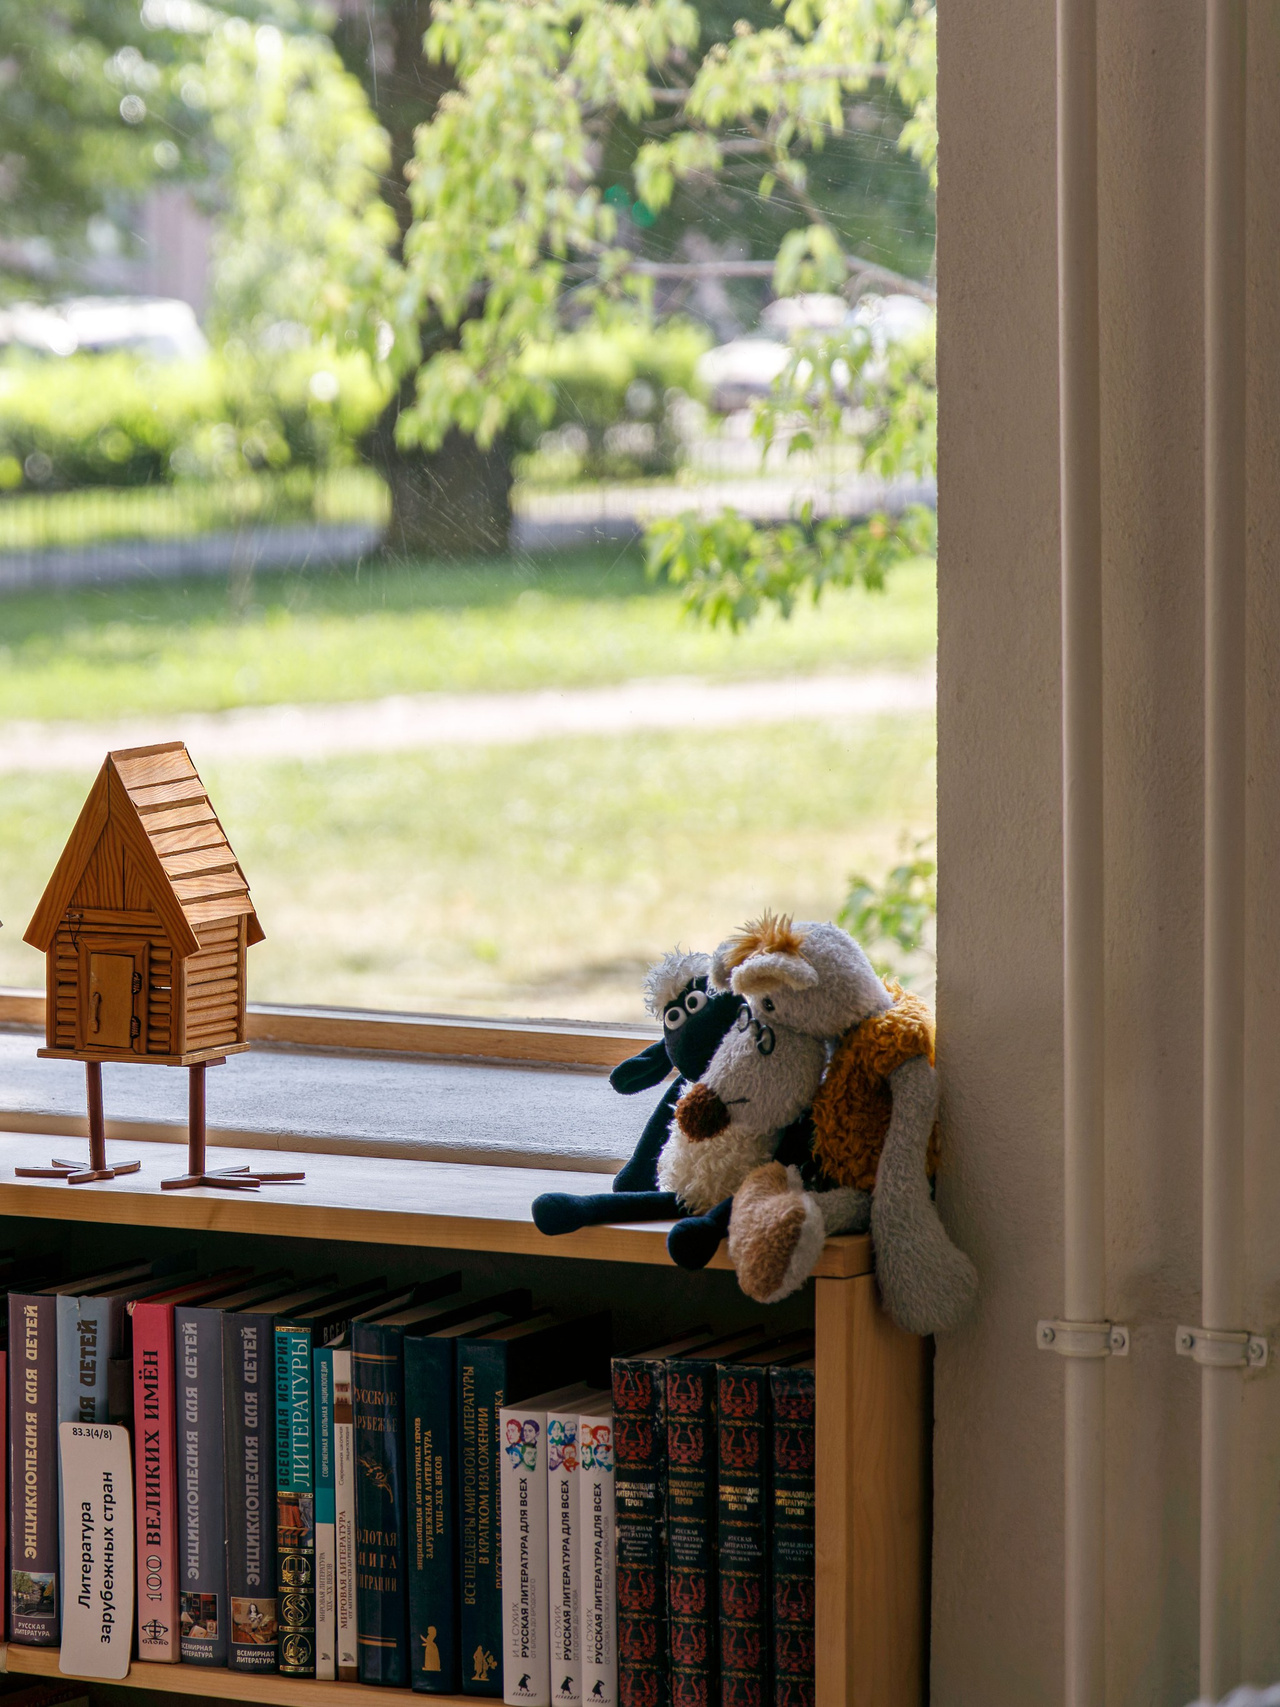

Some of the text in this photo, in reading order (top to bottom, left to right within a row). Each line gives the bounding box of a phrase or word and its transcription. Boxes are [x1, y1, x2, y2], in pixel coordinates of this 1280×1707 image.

[23, 1305, 38, 1559] ЭНЦИКЛОПЕДИЯ ДЛЯ ДЕТЕЙ
[72, 1428, 112, 1441] 83.3(4/8)
[182, 1322, 199, 1578] ЭНЦИКЛОПЕДИЯ ДЛЯ ДЕТЕЙ
[241, 1326, 260, 1585] ЭНЦИКЛОПЕДИЯ ДЛЯ ДЕТЕЙ
[277, 1336, 290, 1486] ВСЕОБЩАЯ ИСТОРИЯ
[291, 1337, 310, 1486] ЛИТЕРАТУРЫ
[138, 1350, 162, 1601] 100 ВЕЛИКИХ ИМЁН
[424, 1431, 433, 1559] ЗАРУБЕЖНАЯ ЛИТЕРАТУРА
[462, 1366, 476, 1605] ВСЕ ШЕДЕВРЫ МИРОВОЙ ЛИТЕРАТУРЫ
[478, 1408, 490, 1564] В КРАТКОМ ИЗЛОЖЕНИИ
[520, 1478, 528, 1506] ВСЕХ
[521, 1509, 529, 1533] ДЛЯ
[78, 1502, 95, 1608] Литература
[100, 1472, 117, 1643] зарубежных стран
[339, 1510, 348, 1629] МИРОВАЯ ЛИТЕРАТУРА
[347, 1560, 353, 1568] ДО
[521, 1535, 529, 1605] ЛИТЕРАТУРА
[561, 1480, 572, 1660] РУССКАЯ ЛИТЕРАТУРА ДЛЯ ВСЕХ
[593, 1483, 603, 1664] РУССКАЯ ЛИТЕРАТУРА ДЛЯ ВСЕХ
[512, 1603, 520, 1657] И. Н. СУХИХ
[554, 1605, 562, 1660] И. Н. СУХИХ
[586, 1643, 593, 1652] Н.
[586, 1654, 593, 1663] И.
